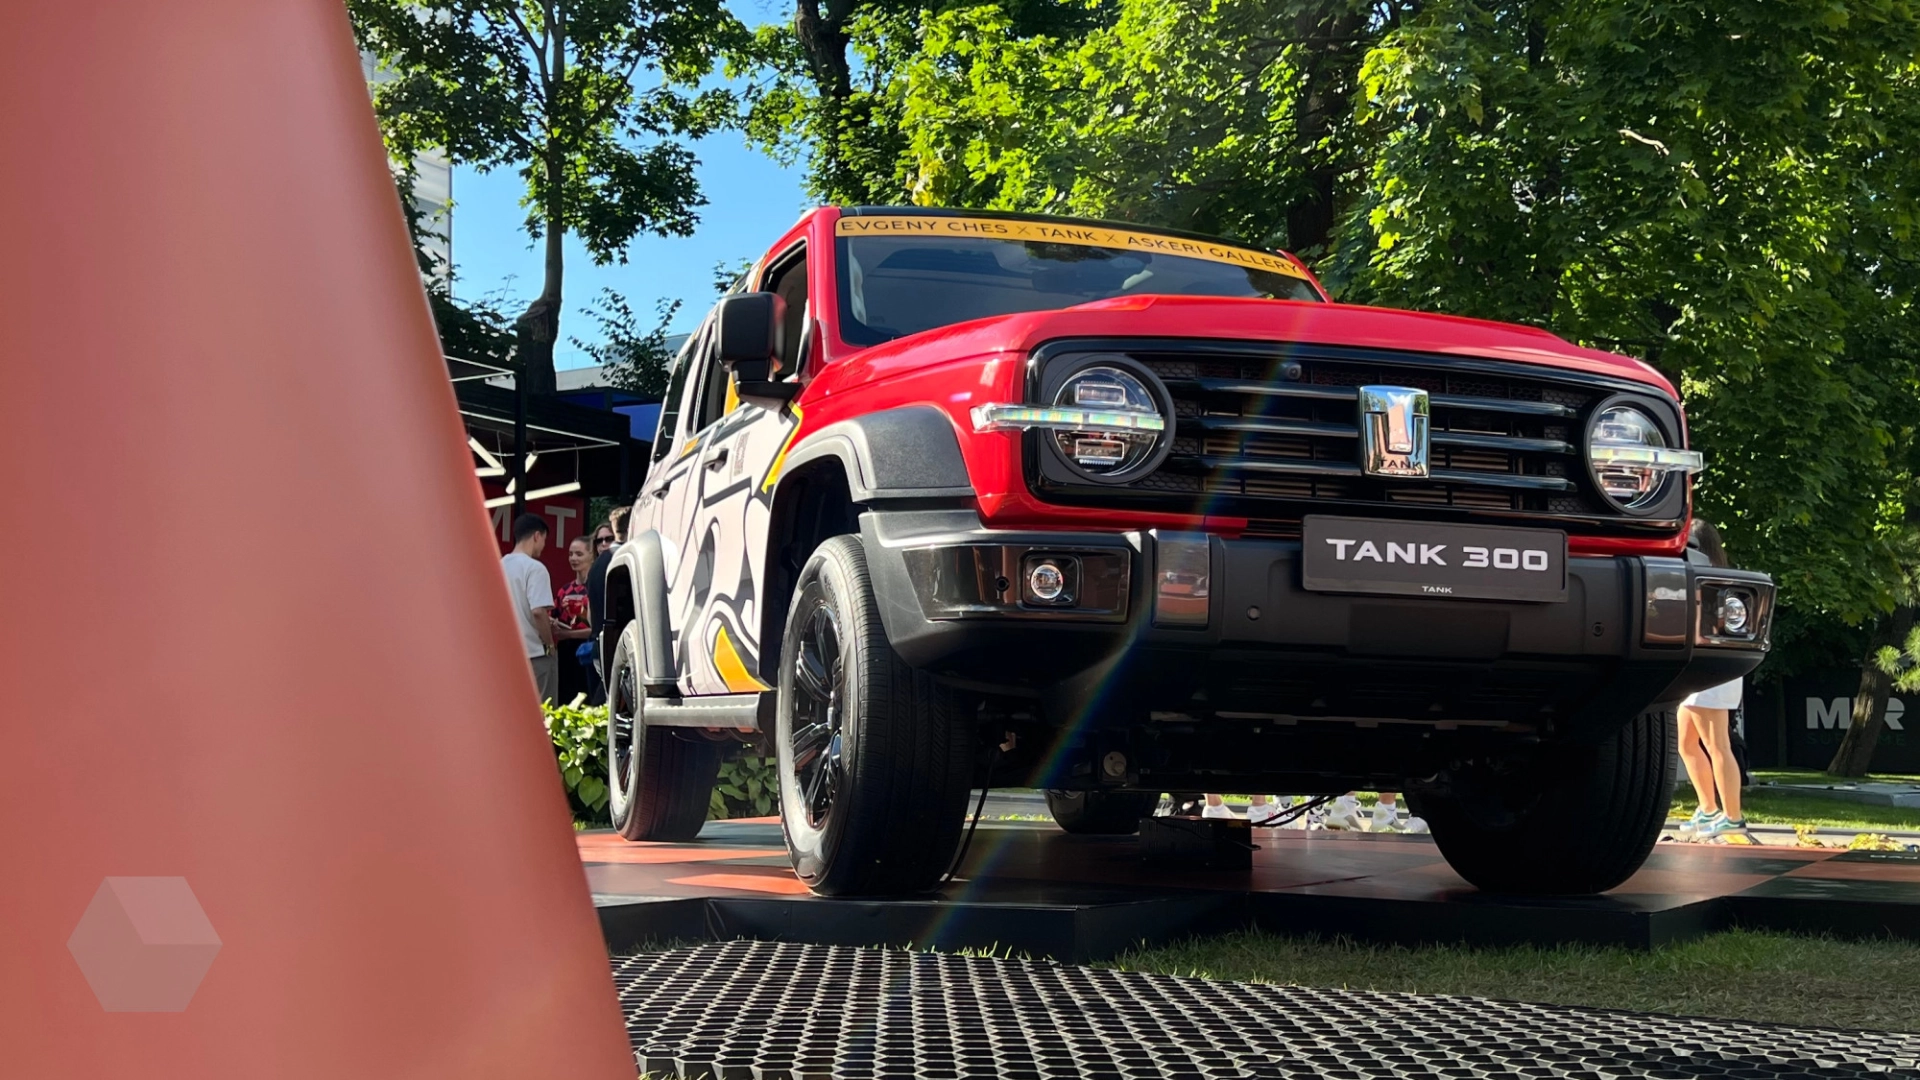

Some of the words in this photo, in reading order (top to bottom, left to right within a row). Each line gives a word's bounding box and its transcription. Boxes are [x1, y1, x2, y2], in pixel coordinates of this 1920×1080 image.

[841, 220, 938, 231] EVGENY
[947, 222, 1008, 234] CHES
[1036, 227, 1098, 242] TANK
[1128, 236, 1203, 255] ASKERI
[1209, 247, 1298, 274] GALLERY
[1325, 538, 1447, 566] TANK
[1462, 546, 1548, 571] 300
[1421, 585, 1453, 594] TANK
[1805, 696, 1906, 731] MR
